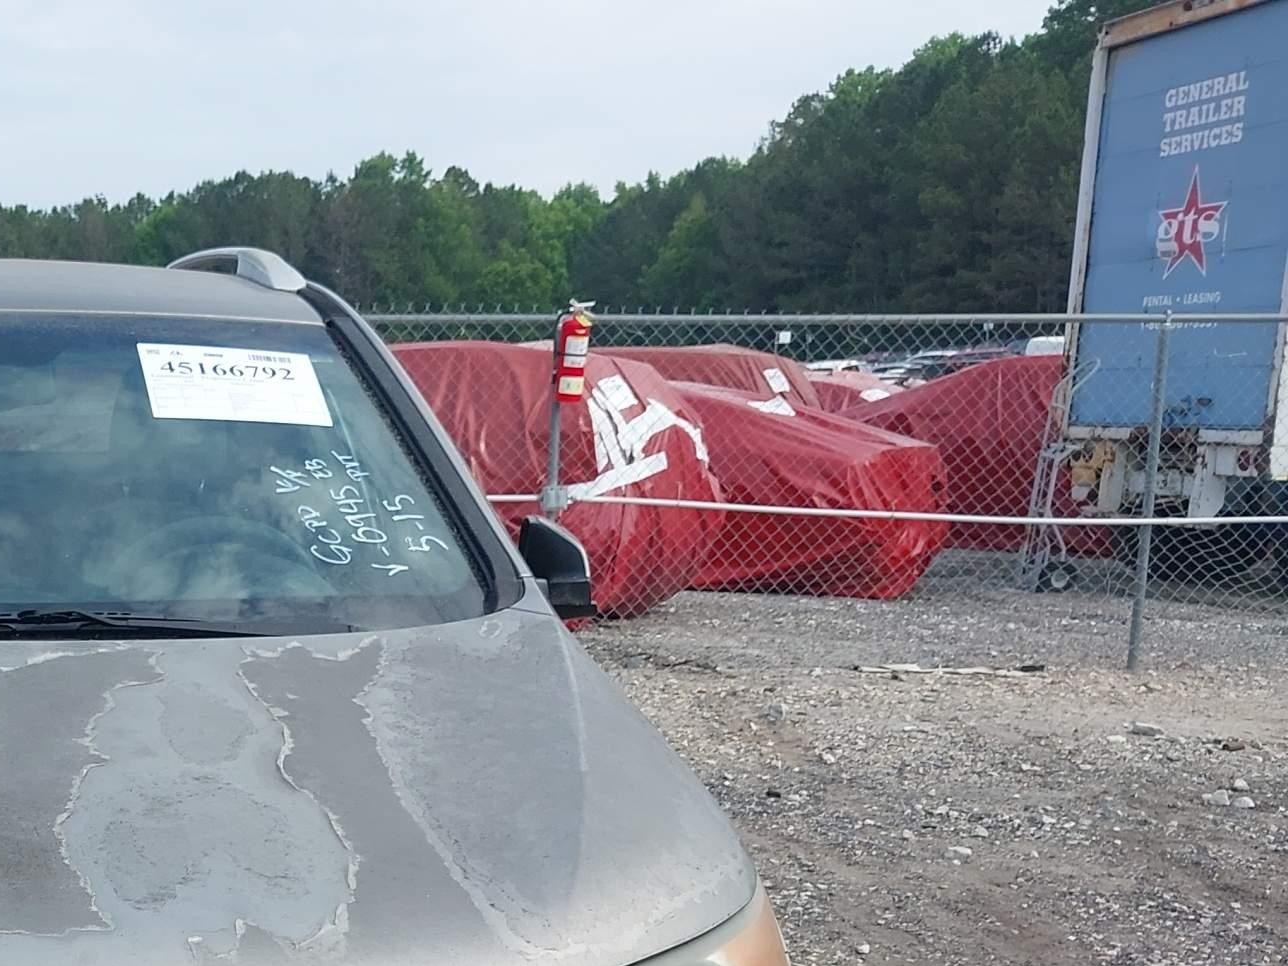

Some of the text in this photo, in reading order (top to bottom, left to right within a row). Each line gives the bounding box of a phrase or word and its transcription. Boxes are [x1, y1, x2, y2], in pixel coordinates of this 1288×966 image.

[1165, 71, 1249, 108] GENERAL
[1163, 96, 1246, 133] TRAILER
[1160, 123, 1244, 157] SERVICES
[1156, 207, 1220, 260] gts
[160, 360, 295, 381] 45166792
